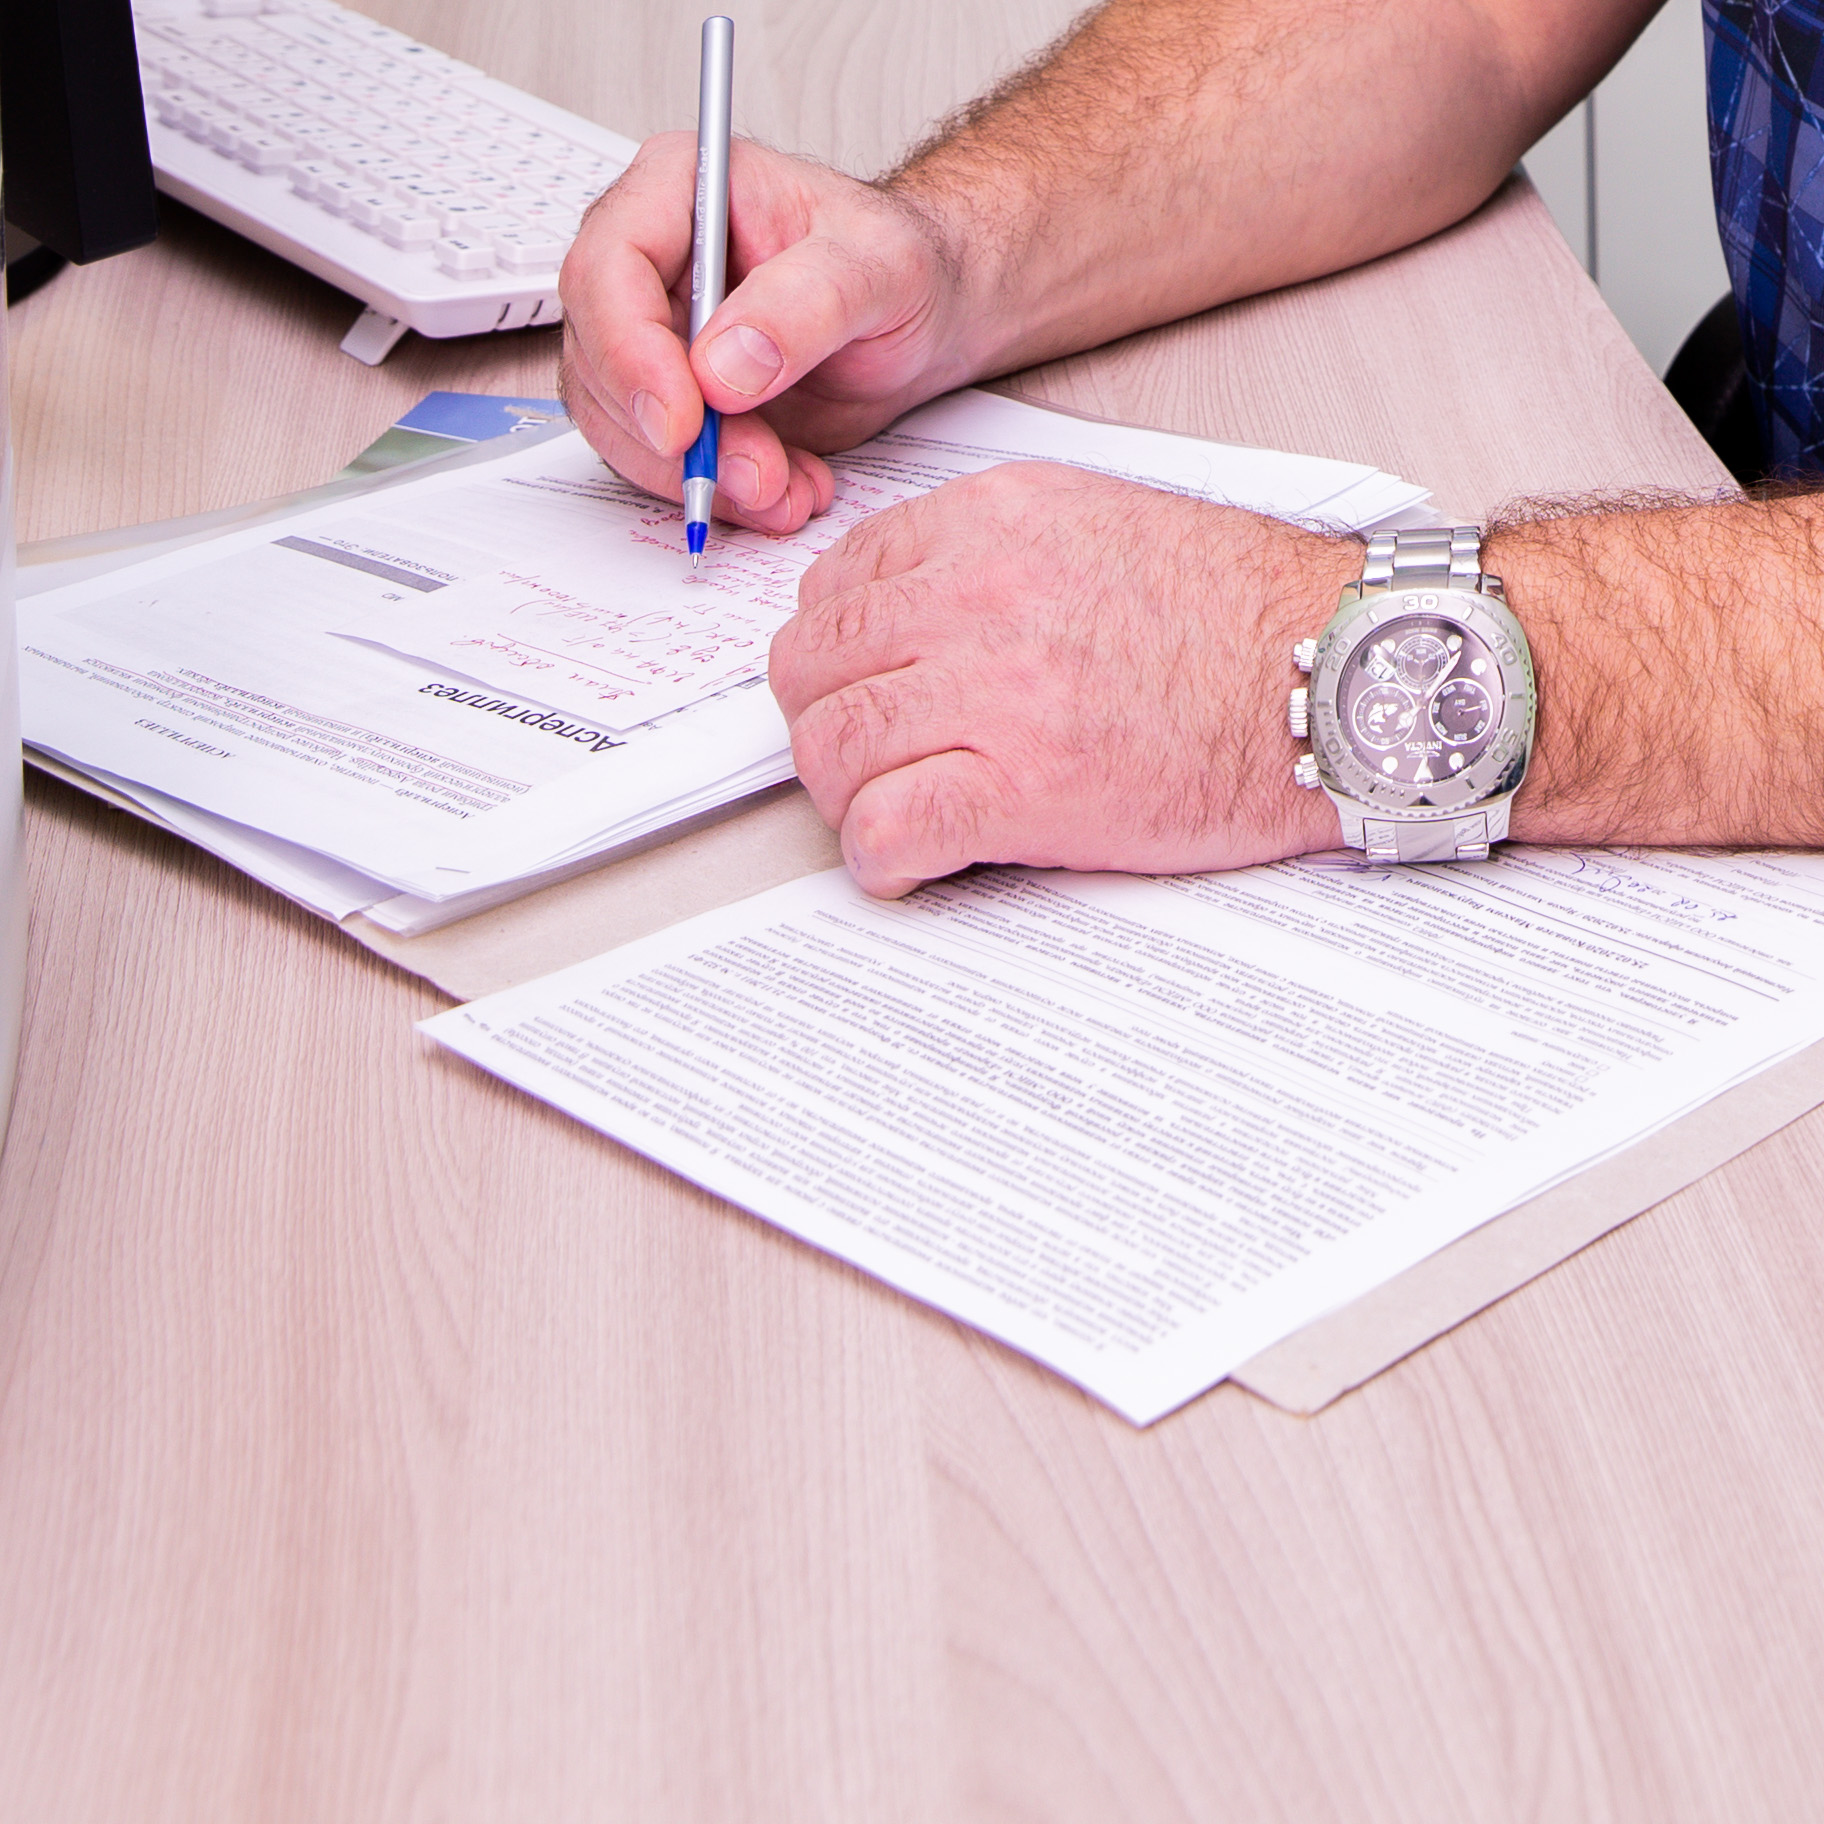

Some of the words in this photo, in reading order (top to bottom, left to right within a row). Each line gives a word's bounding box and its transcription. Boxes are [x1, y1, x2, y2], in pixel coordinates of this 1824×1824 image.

[1402, 593, 1439, 612] 30
[415, 679, 627, 752] Аспергиллез
[133, 717, 236, 761] АСПЕРГИЛЛЕЗ
[1403, 739, 1443, 752] INVICTA
